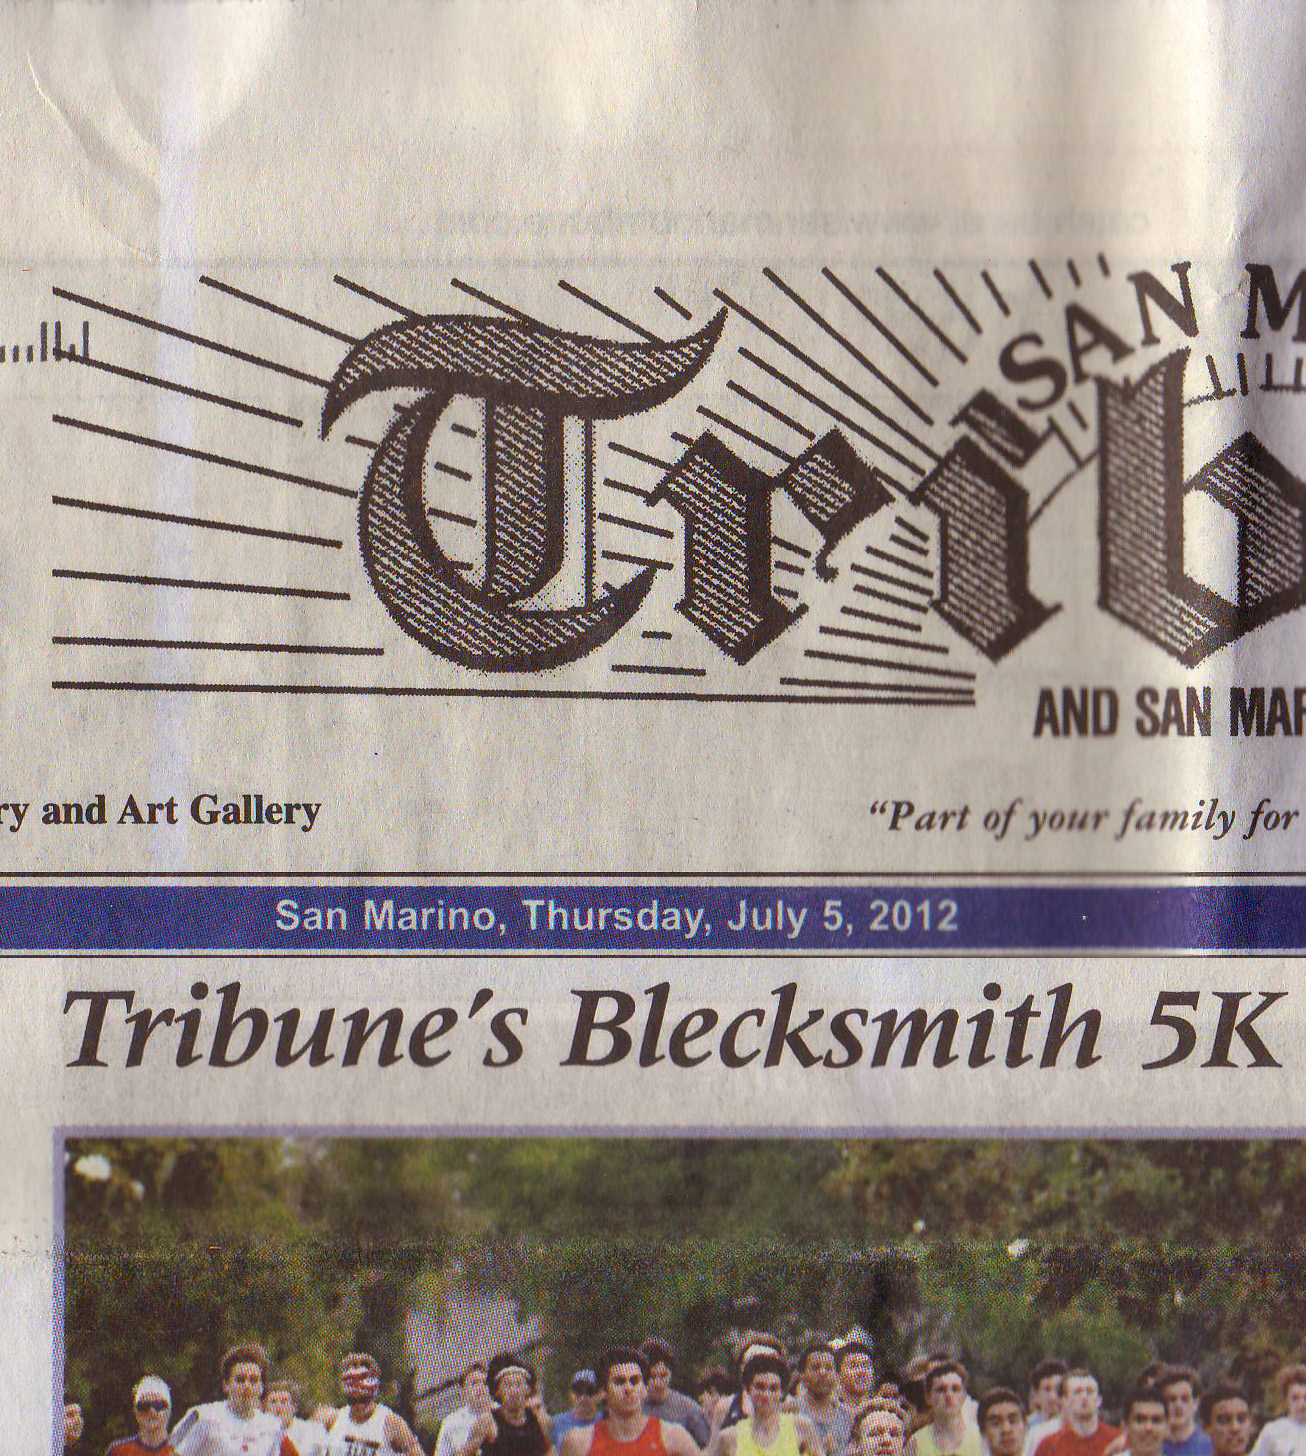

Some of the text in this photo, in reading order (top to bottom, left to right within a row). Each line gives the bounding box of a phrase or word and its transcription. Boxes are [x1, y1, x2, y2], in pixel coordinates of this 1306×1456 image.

[999, 261, 1200, 412] SAN
[1032, 686, 1119, 738] AND
[1135, 685, 1212, 738] SAN
[41, 793, 108, 826] and
[116, 793, 179, 826] Art
[189, 793, 322, 834] Gallery
[983, 801, 1017, 840] of
[1026, 809, 1107, 840] your
[1115, 800, 1237, 840] family
[1244, 800, 1300, 840] for
[275, 898, 958, 939] San Marino, Thursday, July 5, 2012
[62, 980, 529, 1069] Tribune's
[559, 981, 1103, 1070] Blecksmith
[1141, 991, 1286, 1072] 5K
